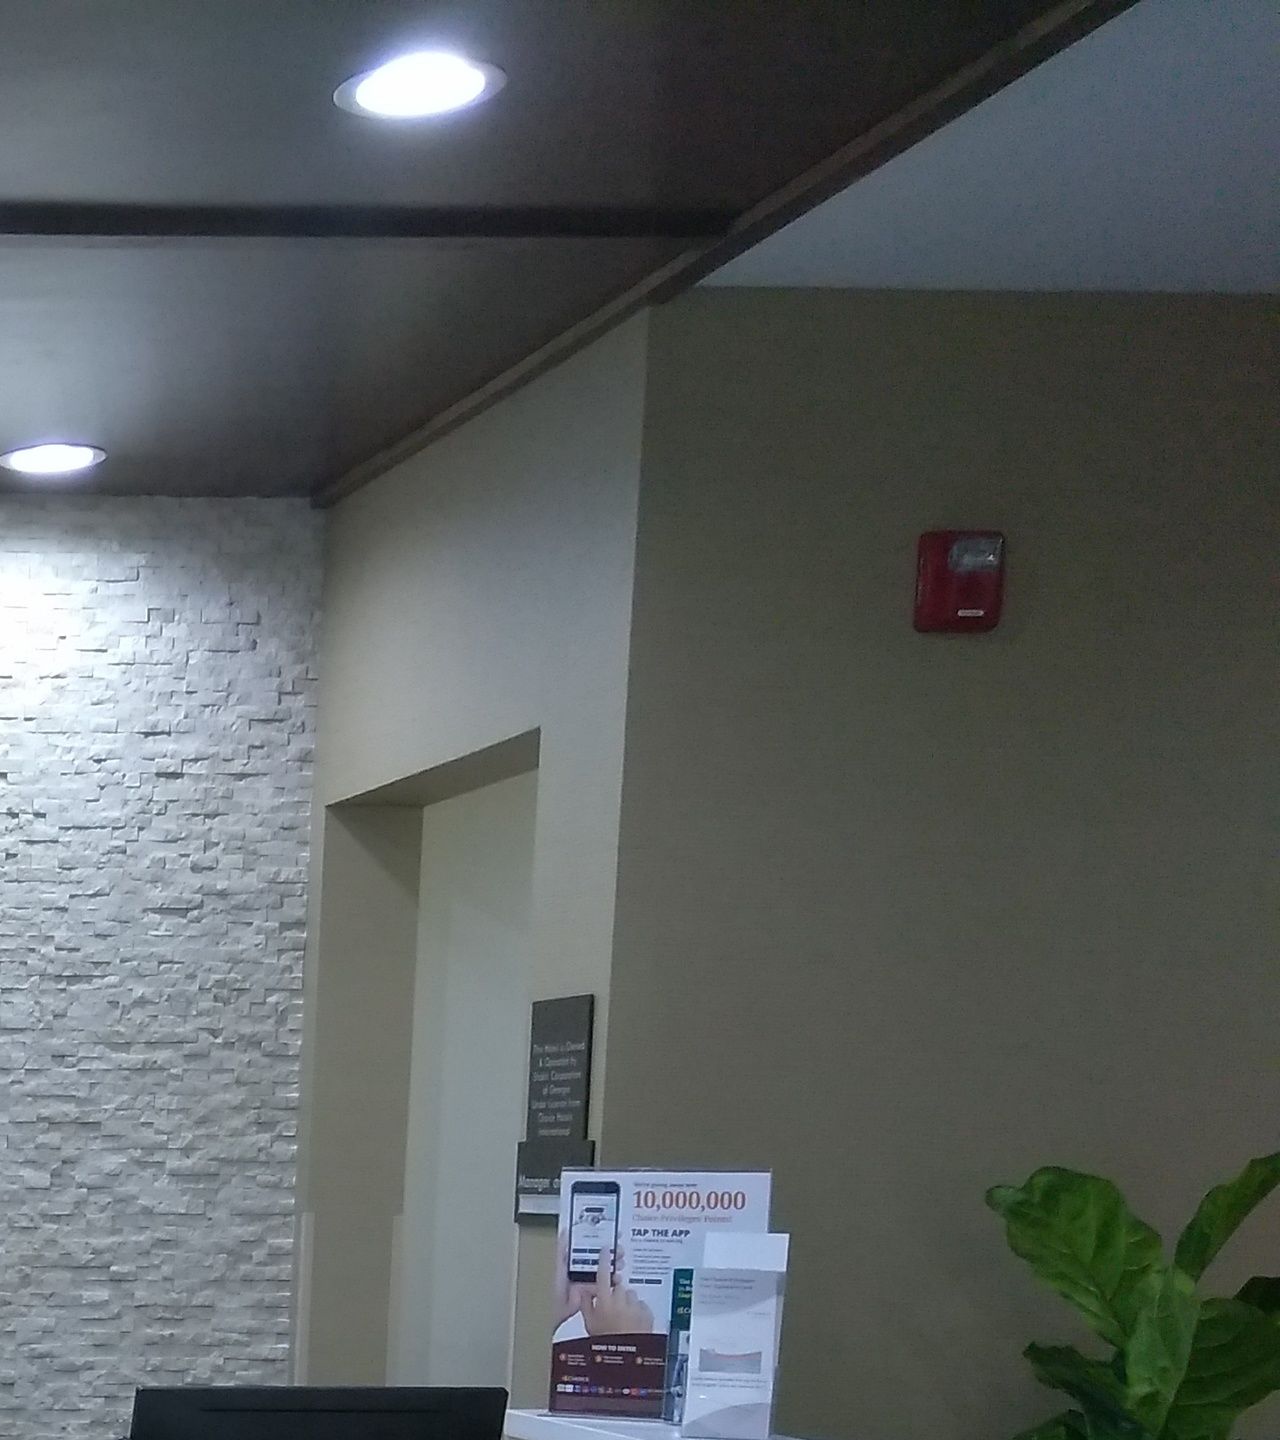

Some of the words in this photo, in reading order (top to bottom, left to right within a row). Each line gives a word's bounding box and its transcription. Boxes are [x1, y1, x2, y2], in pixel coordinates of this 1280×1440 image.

[633, 1190, 746, 1212] 10,000,000
[631, 1228, 649, 1237] TAP
[651, 1229, 669, 1237] THE
[671, 1229, 691, 1237] APP
